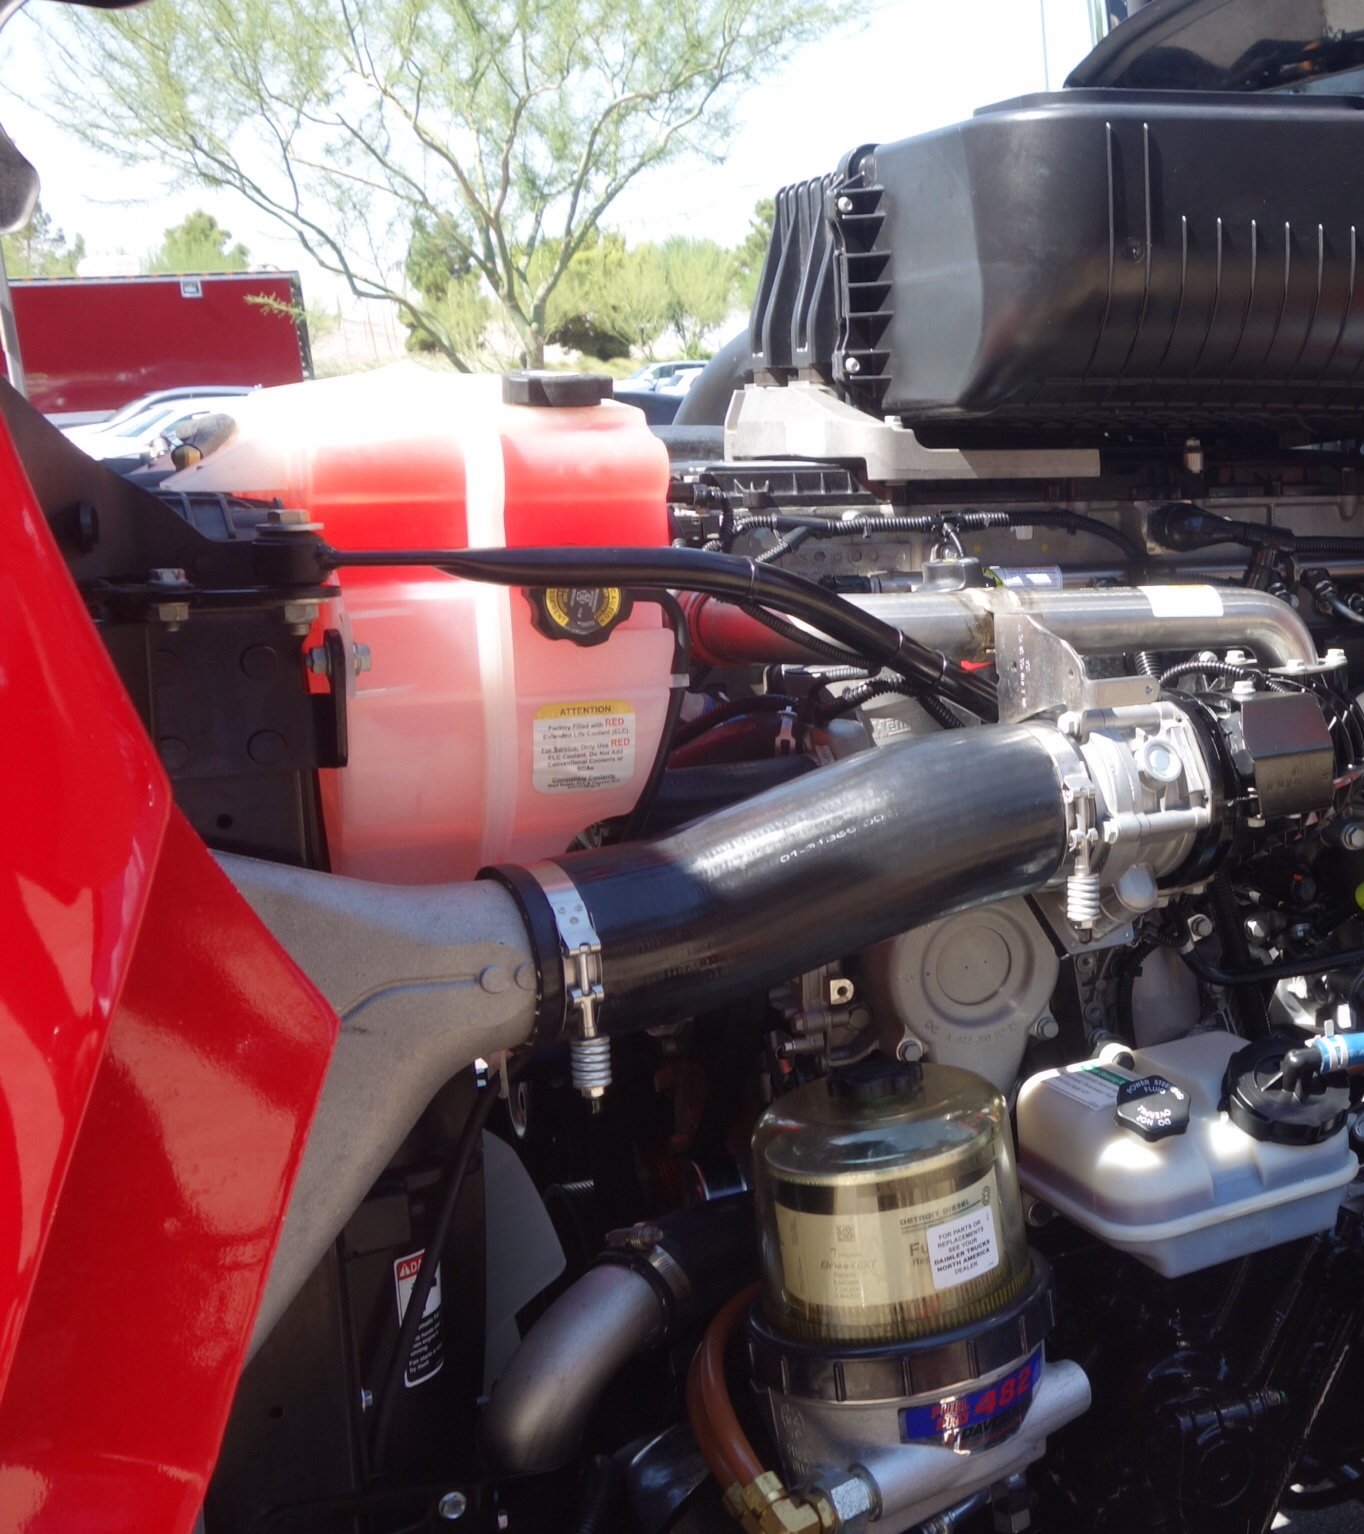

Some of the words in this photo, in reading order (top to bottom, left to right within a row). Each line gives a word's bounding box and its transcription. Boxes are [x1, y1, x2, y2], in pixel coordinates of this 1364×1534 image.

[560, 705, 612, 716] ATTENTION
[604, 717, 624, 727] RED
[610, 738, 630, 747] RED
[1126, 1080, 1150, 1094] POWER
[1144, 1086, 1166, 1094] FLUID
[1136, 1114, 1154, 1126] NOT
[1158, 1118, 1172, 1126] DO
[900, 1210, 940, 1226] DETROIT
[942, 1199, 969, 1215] DIESEL
[938, 1232, 952, 1240] FOR
[953, 1224, 972, 1236] PARTS
[973, 1220, 981, 1228] OR
[938, 1226, 984, 1249] REPLACEMENTS
[934, 1249, 965, 1266] DAIMLER
[966, 1240, 990, 1254] TRUCKS
[948, 1244, 960, 1254] SEE
[962, 1238, 978, 1249] YOUR
[936, 1259, 962, 1272] NORTH
[963, 1248, 990, 1263] AMERICA
[954, 1261, 978, 1275] DEALER
[974, 1366, 1031, 1414] 482
